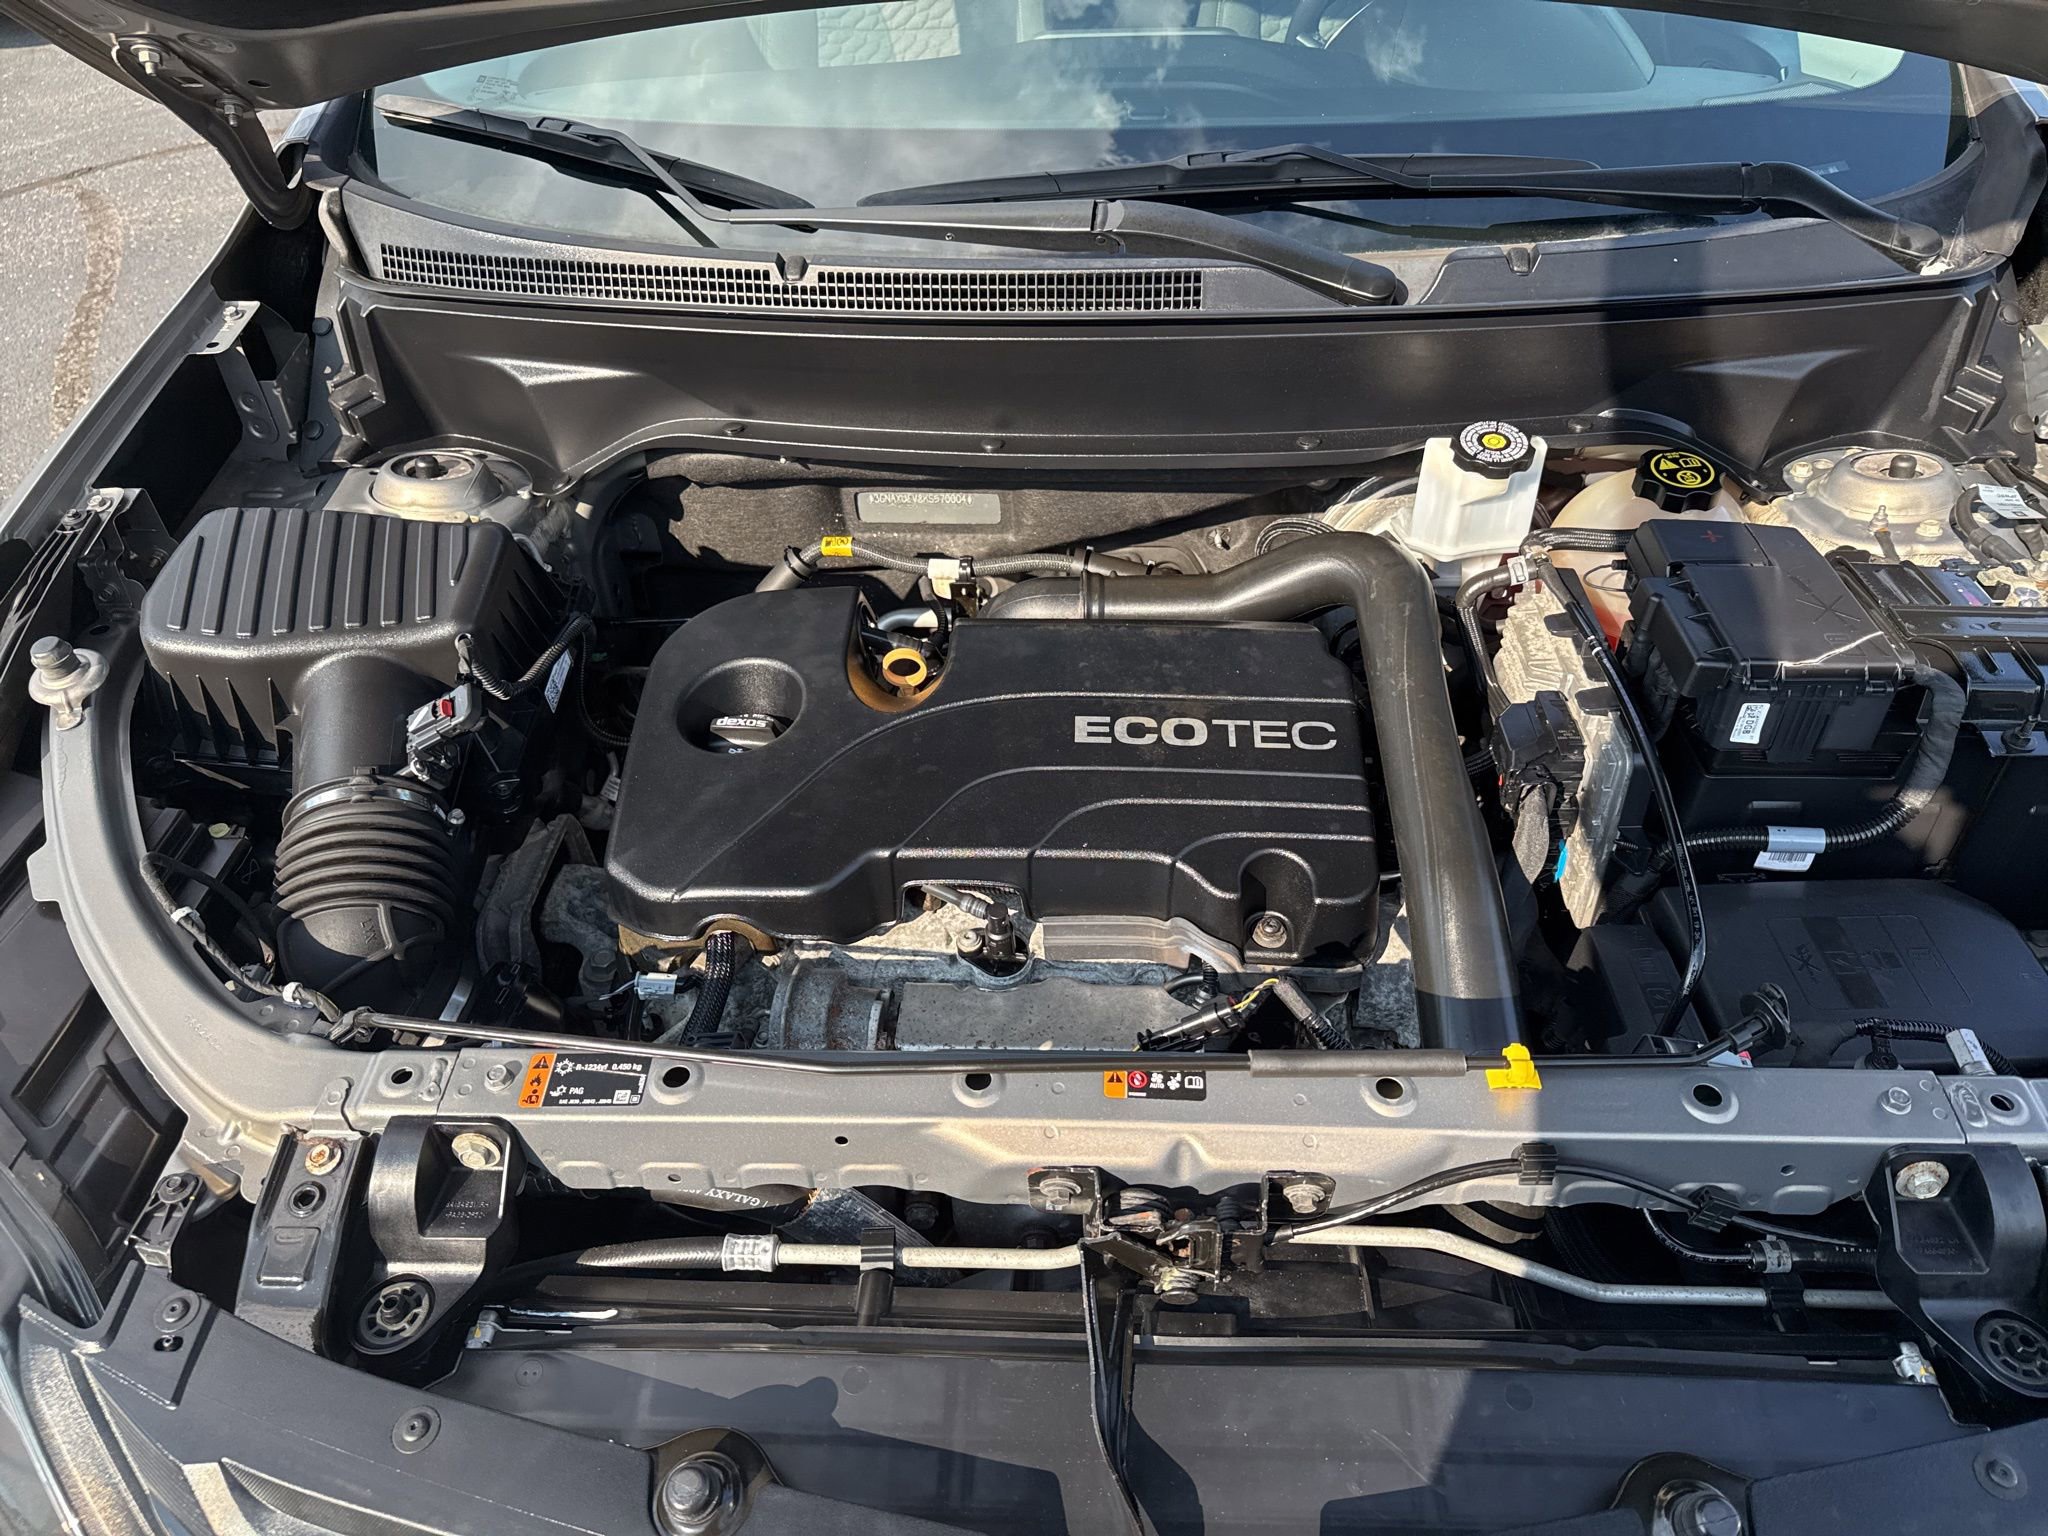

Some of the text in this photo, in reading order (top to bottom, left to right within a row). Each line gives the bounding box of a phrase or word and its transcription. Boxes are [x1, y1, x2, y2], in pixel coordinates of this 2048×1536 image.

[716, 716, 768, 728] dexos
[1074, 715, 1337, 750] ECOTEC
[575, 1063, 642, 1072] R-1234yf 0.450 kg
[568, 1087, 585, 1095] PAG
[704, 1187, 762, 1207] GALAXY
